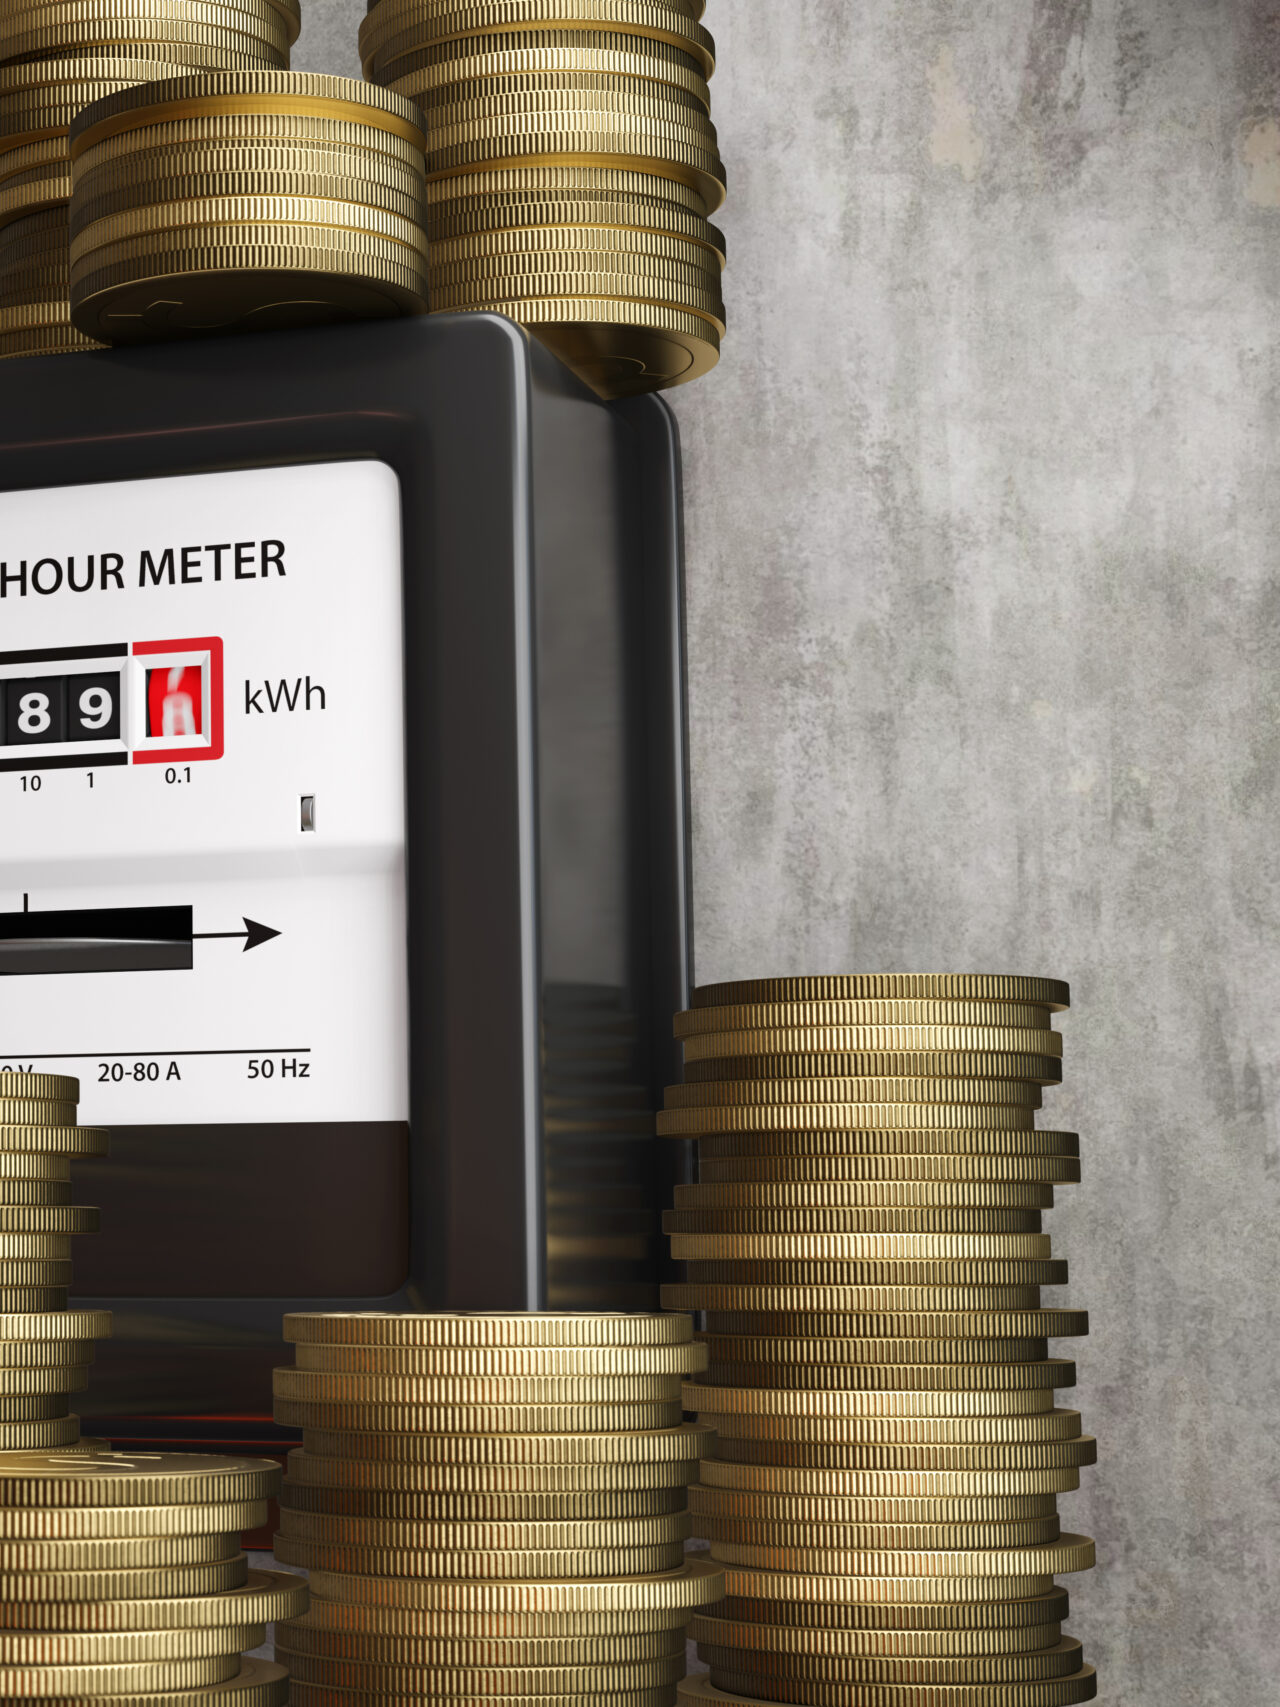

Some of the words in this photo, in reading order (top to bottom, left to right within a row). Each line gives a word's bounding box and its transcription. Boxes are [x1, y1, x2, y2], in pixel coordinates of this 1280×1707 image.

[0, 552, 125, 599] HOUR
[138, 539, 287, 588] METER
[244, 675, 326, 715] kWh
[20, 775, 42, 792] 10
[164, 766, 191, 785] 0.1
[97, 1061, 160, 1083] 20-80
[165, 1061, 182, 1081] A
[247, 1058, 275, 1079] 50
[281, 1058, 311, 1078] Hz
